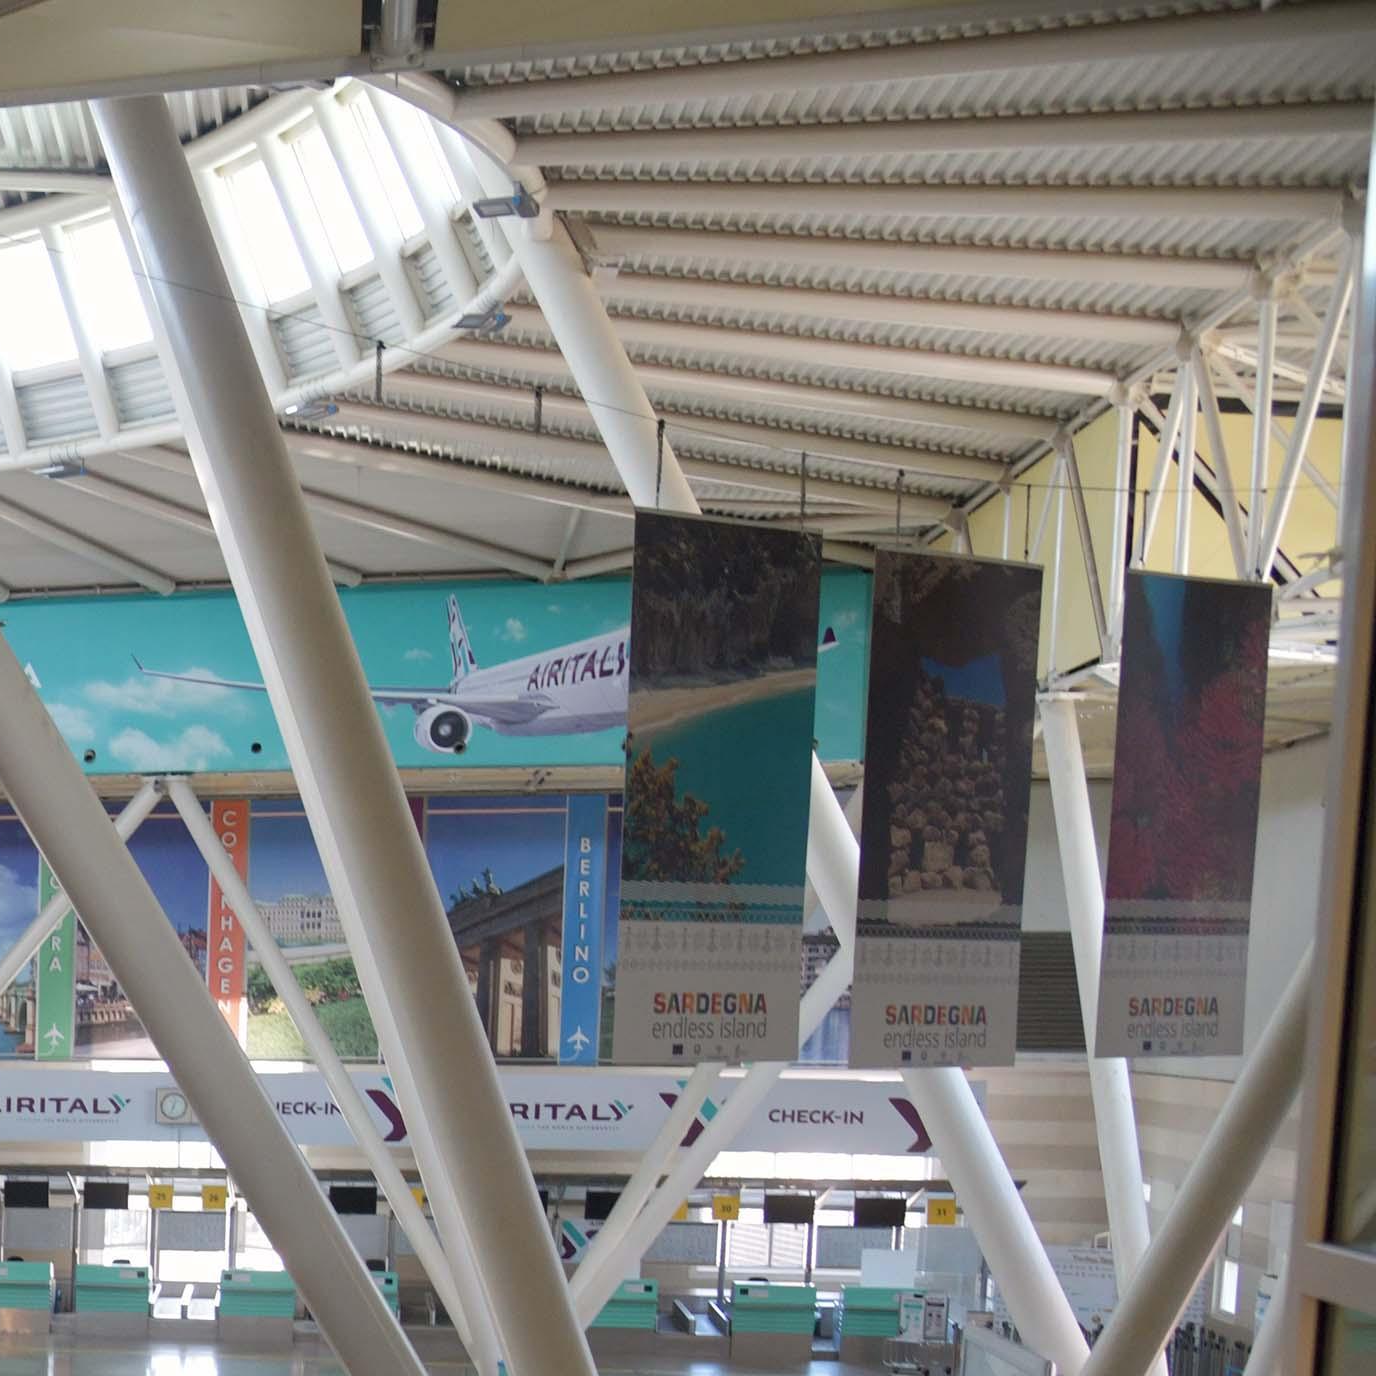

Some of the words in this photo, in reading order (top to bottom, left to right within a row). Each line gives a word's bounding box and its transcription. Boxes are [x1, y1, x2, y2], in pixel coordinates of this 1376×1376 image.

[572, 836, 592, 984] BERLINO
[652, 991, 768, 1015] SARDEGNA
[1128, 996, 1219, 1017] SARDEGNA
[885, 1004, 987, 1026] SARDEGNA
[651, 1016, 715, 1039] endless
[719, 1016, 768, 1039] island
[883, 1026, 941, 1049] endless
[943, 1026, 987, 1049] island
[1127, 1018, 1177, 1039] endless
[1182, 1018, 1218, 1039] island
[276, 1101, 341, 1115] ECK-IN
[509, 1099, 634, 1121] RITALY
[768, 1109, 864, 1125] CHECK-IN
